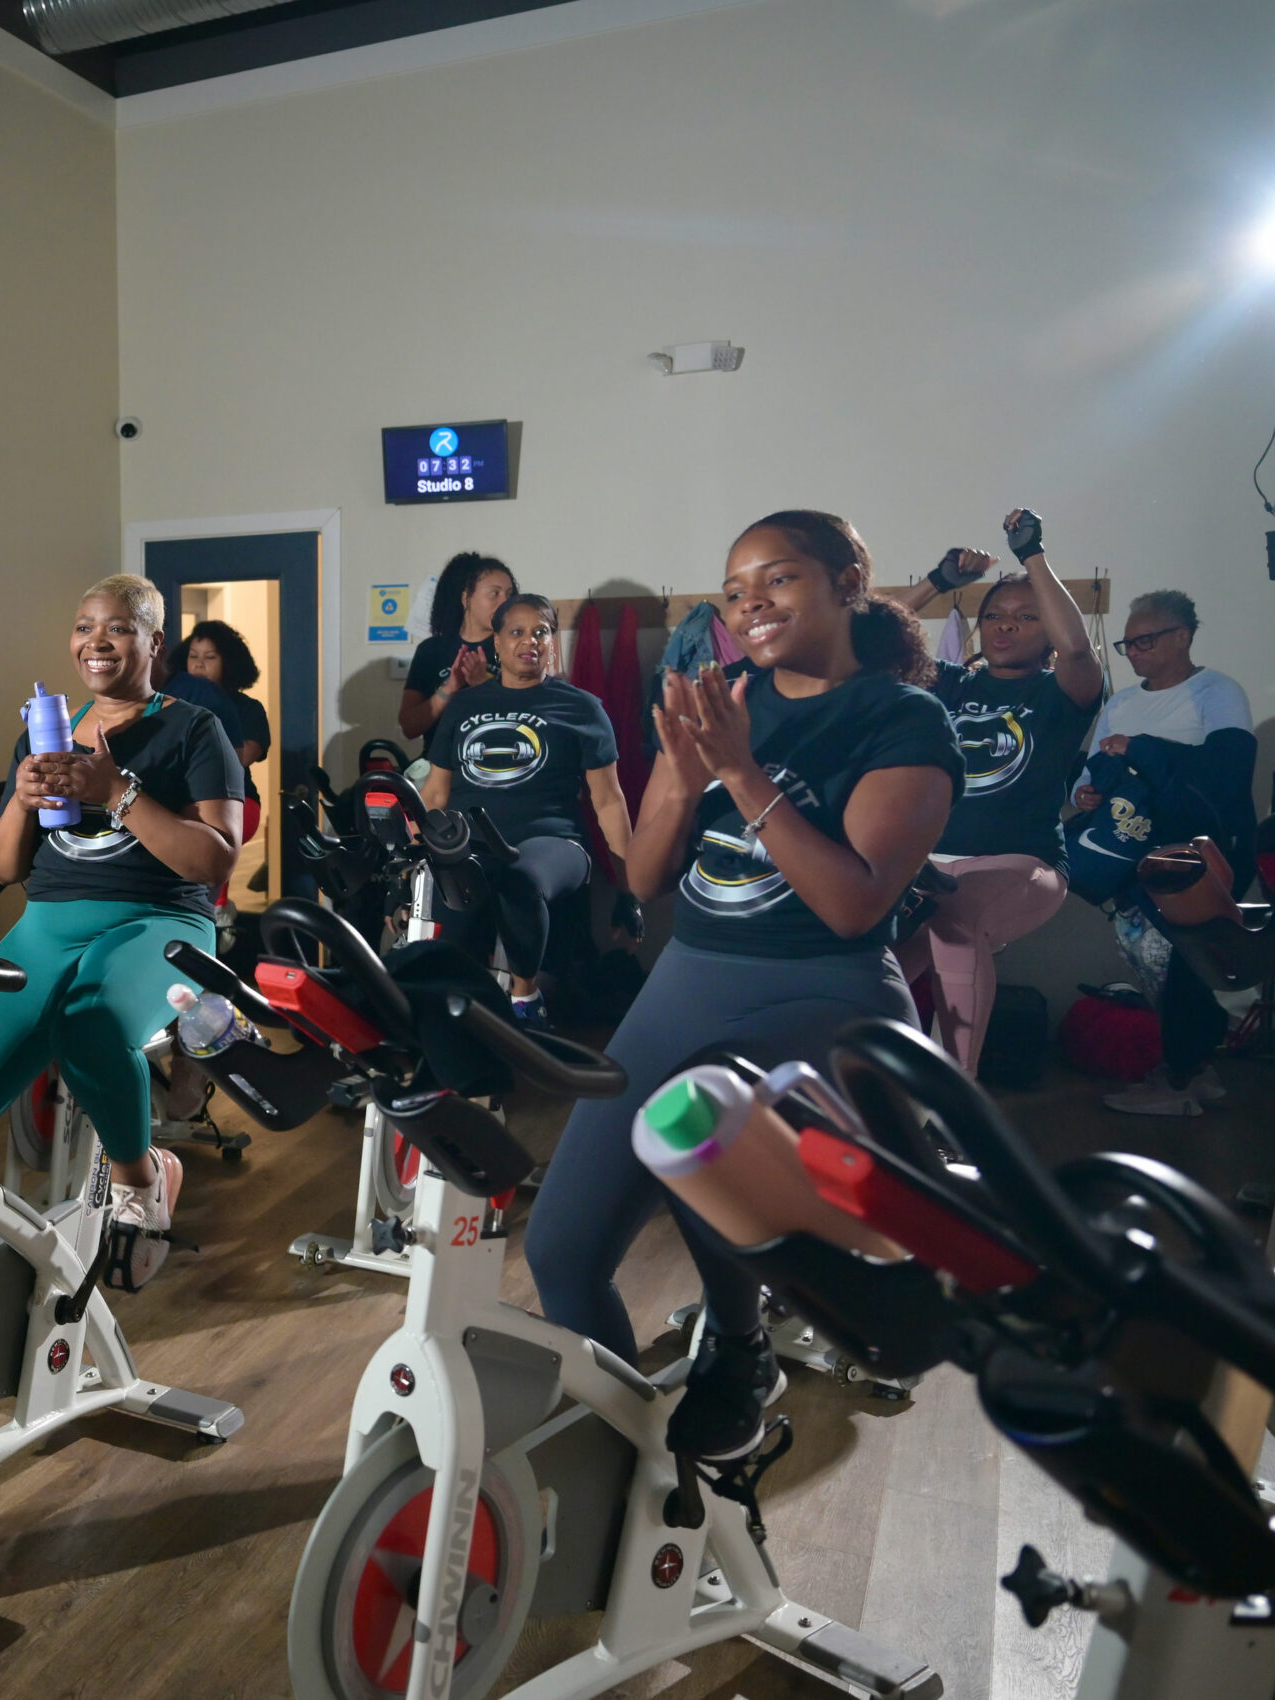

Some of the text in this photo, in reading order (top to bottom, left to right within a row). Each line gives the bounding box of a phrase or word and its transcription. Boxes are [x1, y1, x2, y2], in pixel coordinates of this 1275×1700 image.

[417, 476, 474, 493] Studio 8
[459, 712, 548, 732] CYCLEFIT
[450, 1215, 480, 1247] 25
[429, 1467, 479, 1700] CHWINN
